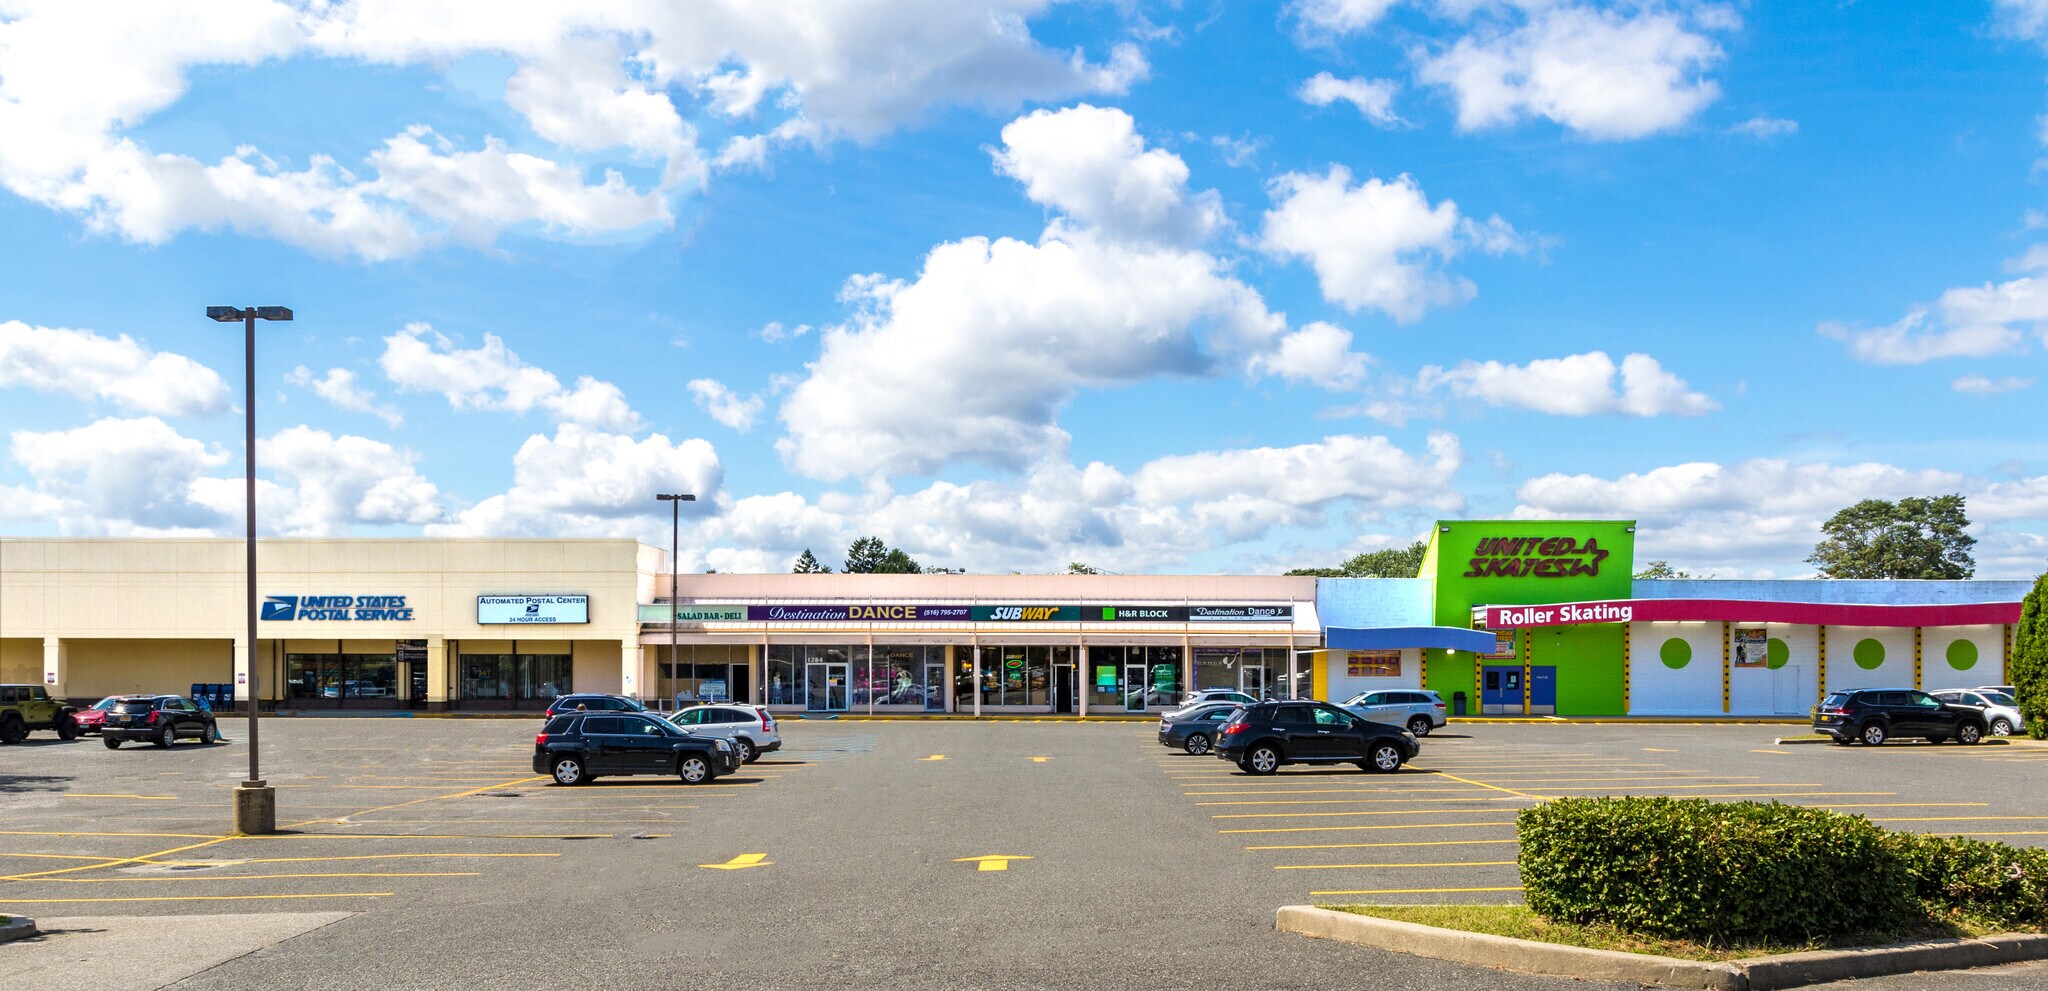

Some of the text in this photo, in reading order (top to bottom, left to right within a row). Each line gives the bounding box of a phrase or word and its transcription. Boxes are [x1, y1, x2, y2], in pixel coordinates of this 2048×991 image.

[1475, 536, 1577, 556] UNITED
[300, 596, 406, 608] UNITED STATES
[480, 597, 525, 605] AUTOMATED
[556, 596, 586, 604] CENTER
[298, 609, 414, 621] POSTAL SERVICE
[677, 612, 742, 620] SALAD BAR DELI
[768, 606, 917, 620] Destination DANCE
[990, 606, 1060, 620] SUBWAY
[1118, 610, 1168, 618] H&R BLOCK
[1197, 607, 1276, 616] Destination Dance
[1500, 604, 1632, 625] Roller Skating
